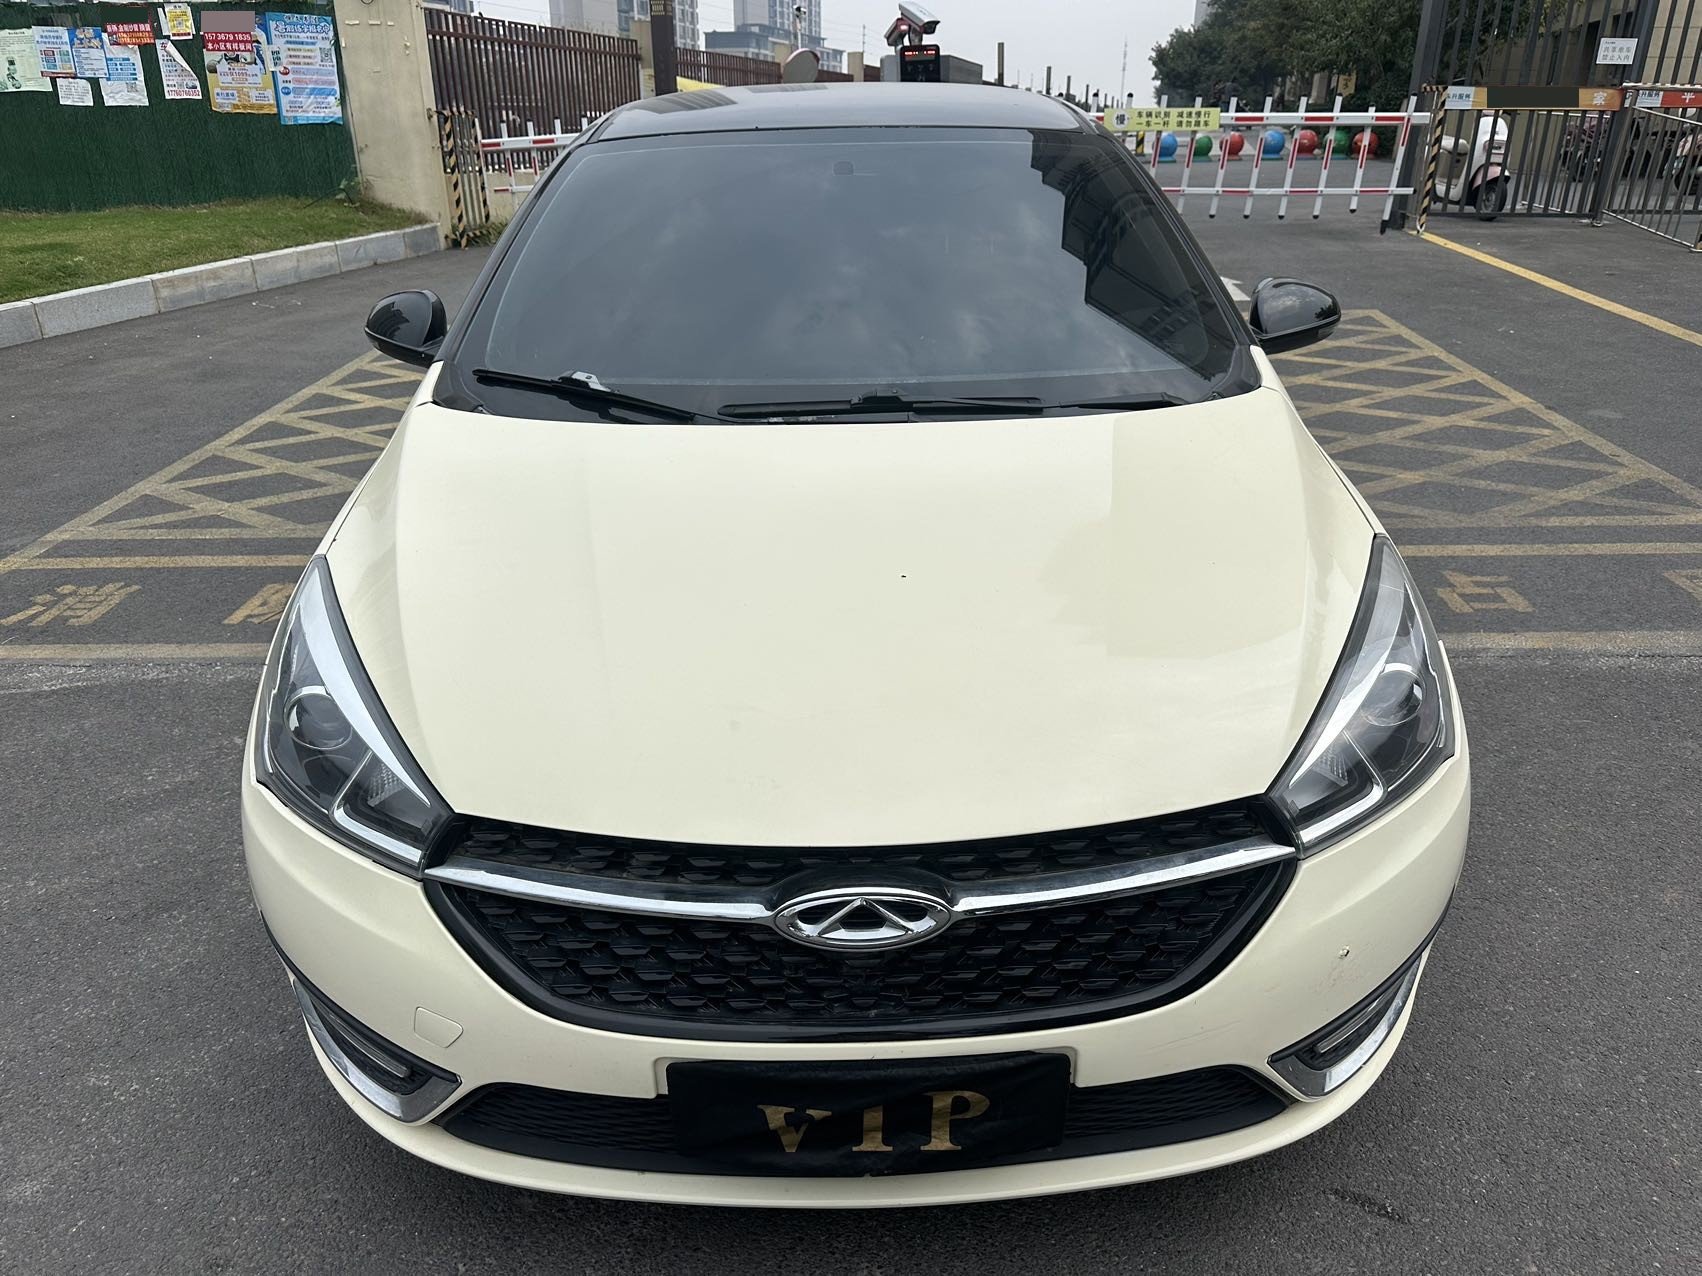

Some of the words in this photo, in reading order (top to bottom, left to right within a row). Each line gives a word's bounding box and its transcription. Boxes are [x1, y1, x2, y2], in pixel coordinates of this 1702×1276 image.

[235, 33, 251, 41] 1835
[1601, 53, 1630, 62] 禁止入内
[1592, 91, 1608, 106] 家
[1681, 91, 1696, 104] 平
[1115, 113, 1127, 125] 慢
[1136, 110, 1171, 119] 车辆识别
[1176, 110, 1211, 119] 减速慢行
[1136, 119, 1170, 128] 一车一杆
[1176, 119, 1211, 128] 请勿跟车
[757, 1090, 991, 1152] VIP
